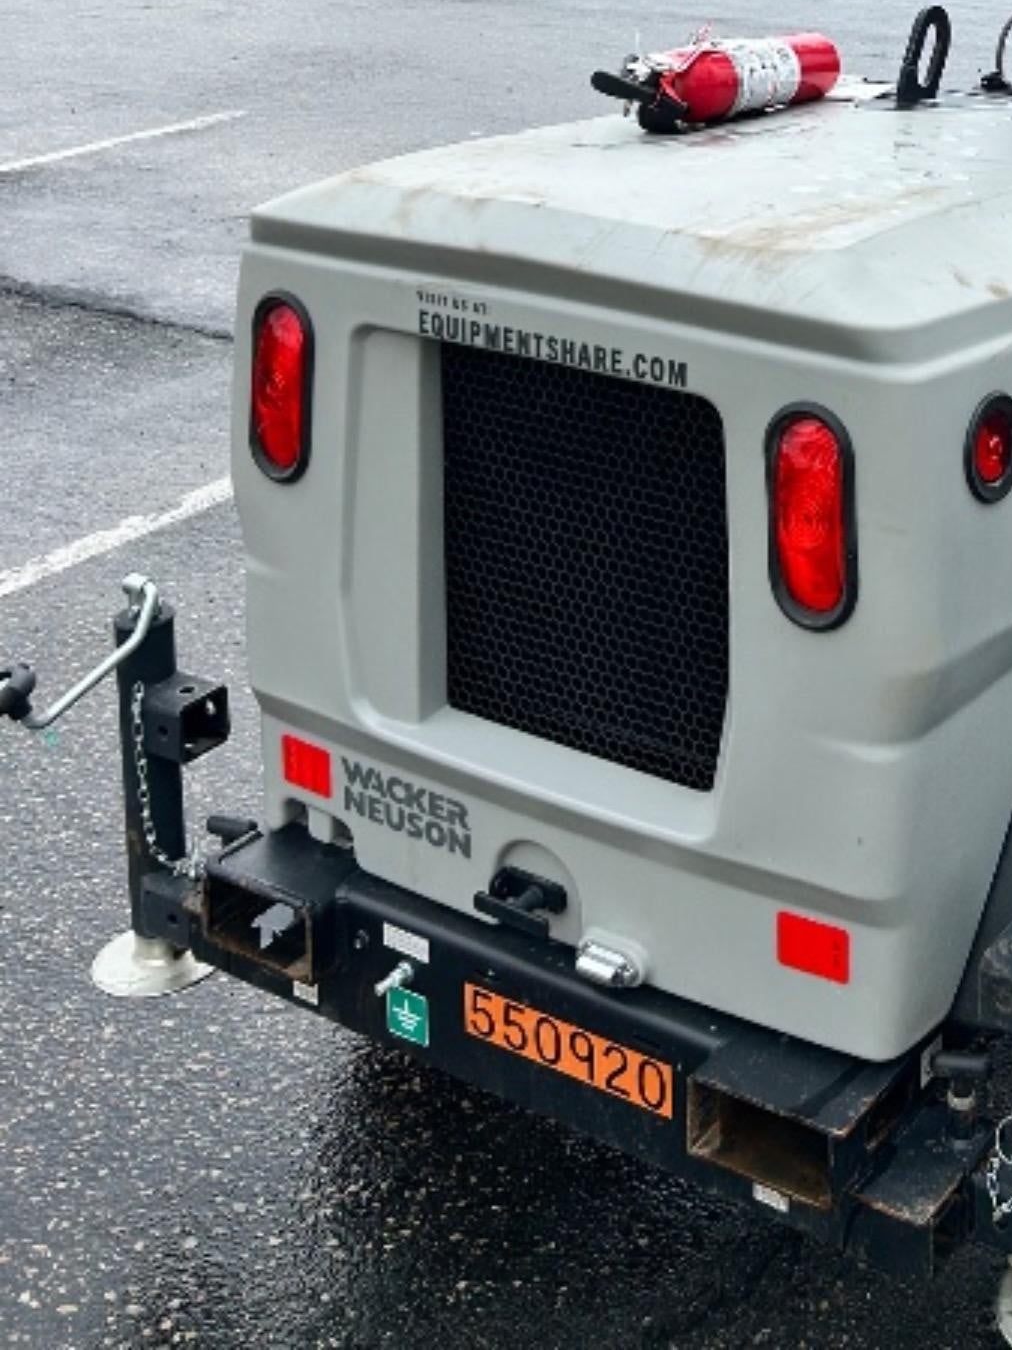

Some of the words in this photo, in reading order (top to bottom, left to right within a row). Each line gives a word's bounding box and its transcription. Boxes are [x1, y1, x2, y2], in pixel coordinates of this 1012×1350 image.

[418, 309, 688, 388] EQUIPMENTSHARE.COM
[341, 756, 470, 832] WACKER
[343, 786, 472, 859] NEUSON
[470, 988, 668, 1111] 550920
